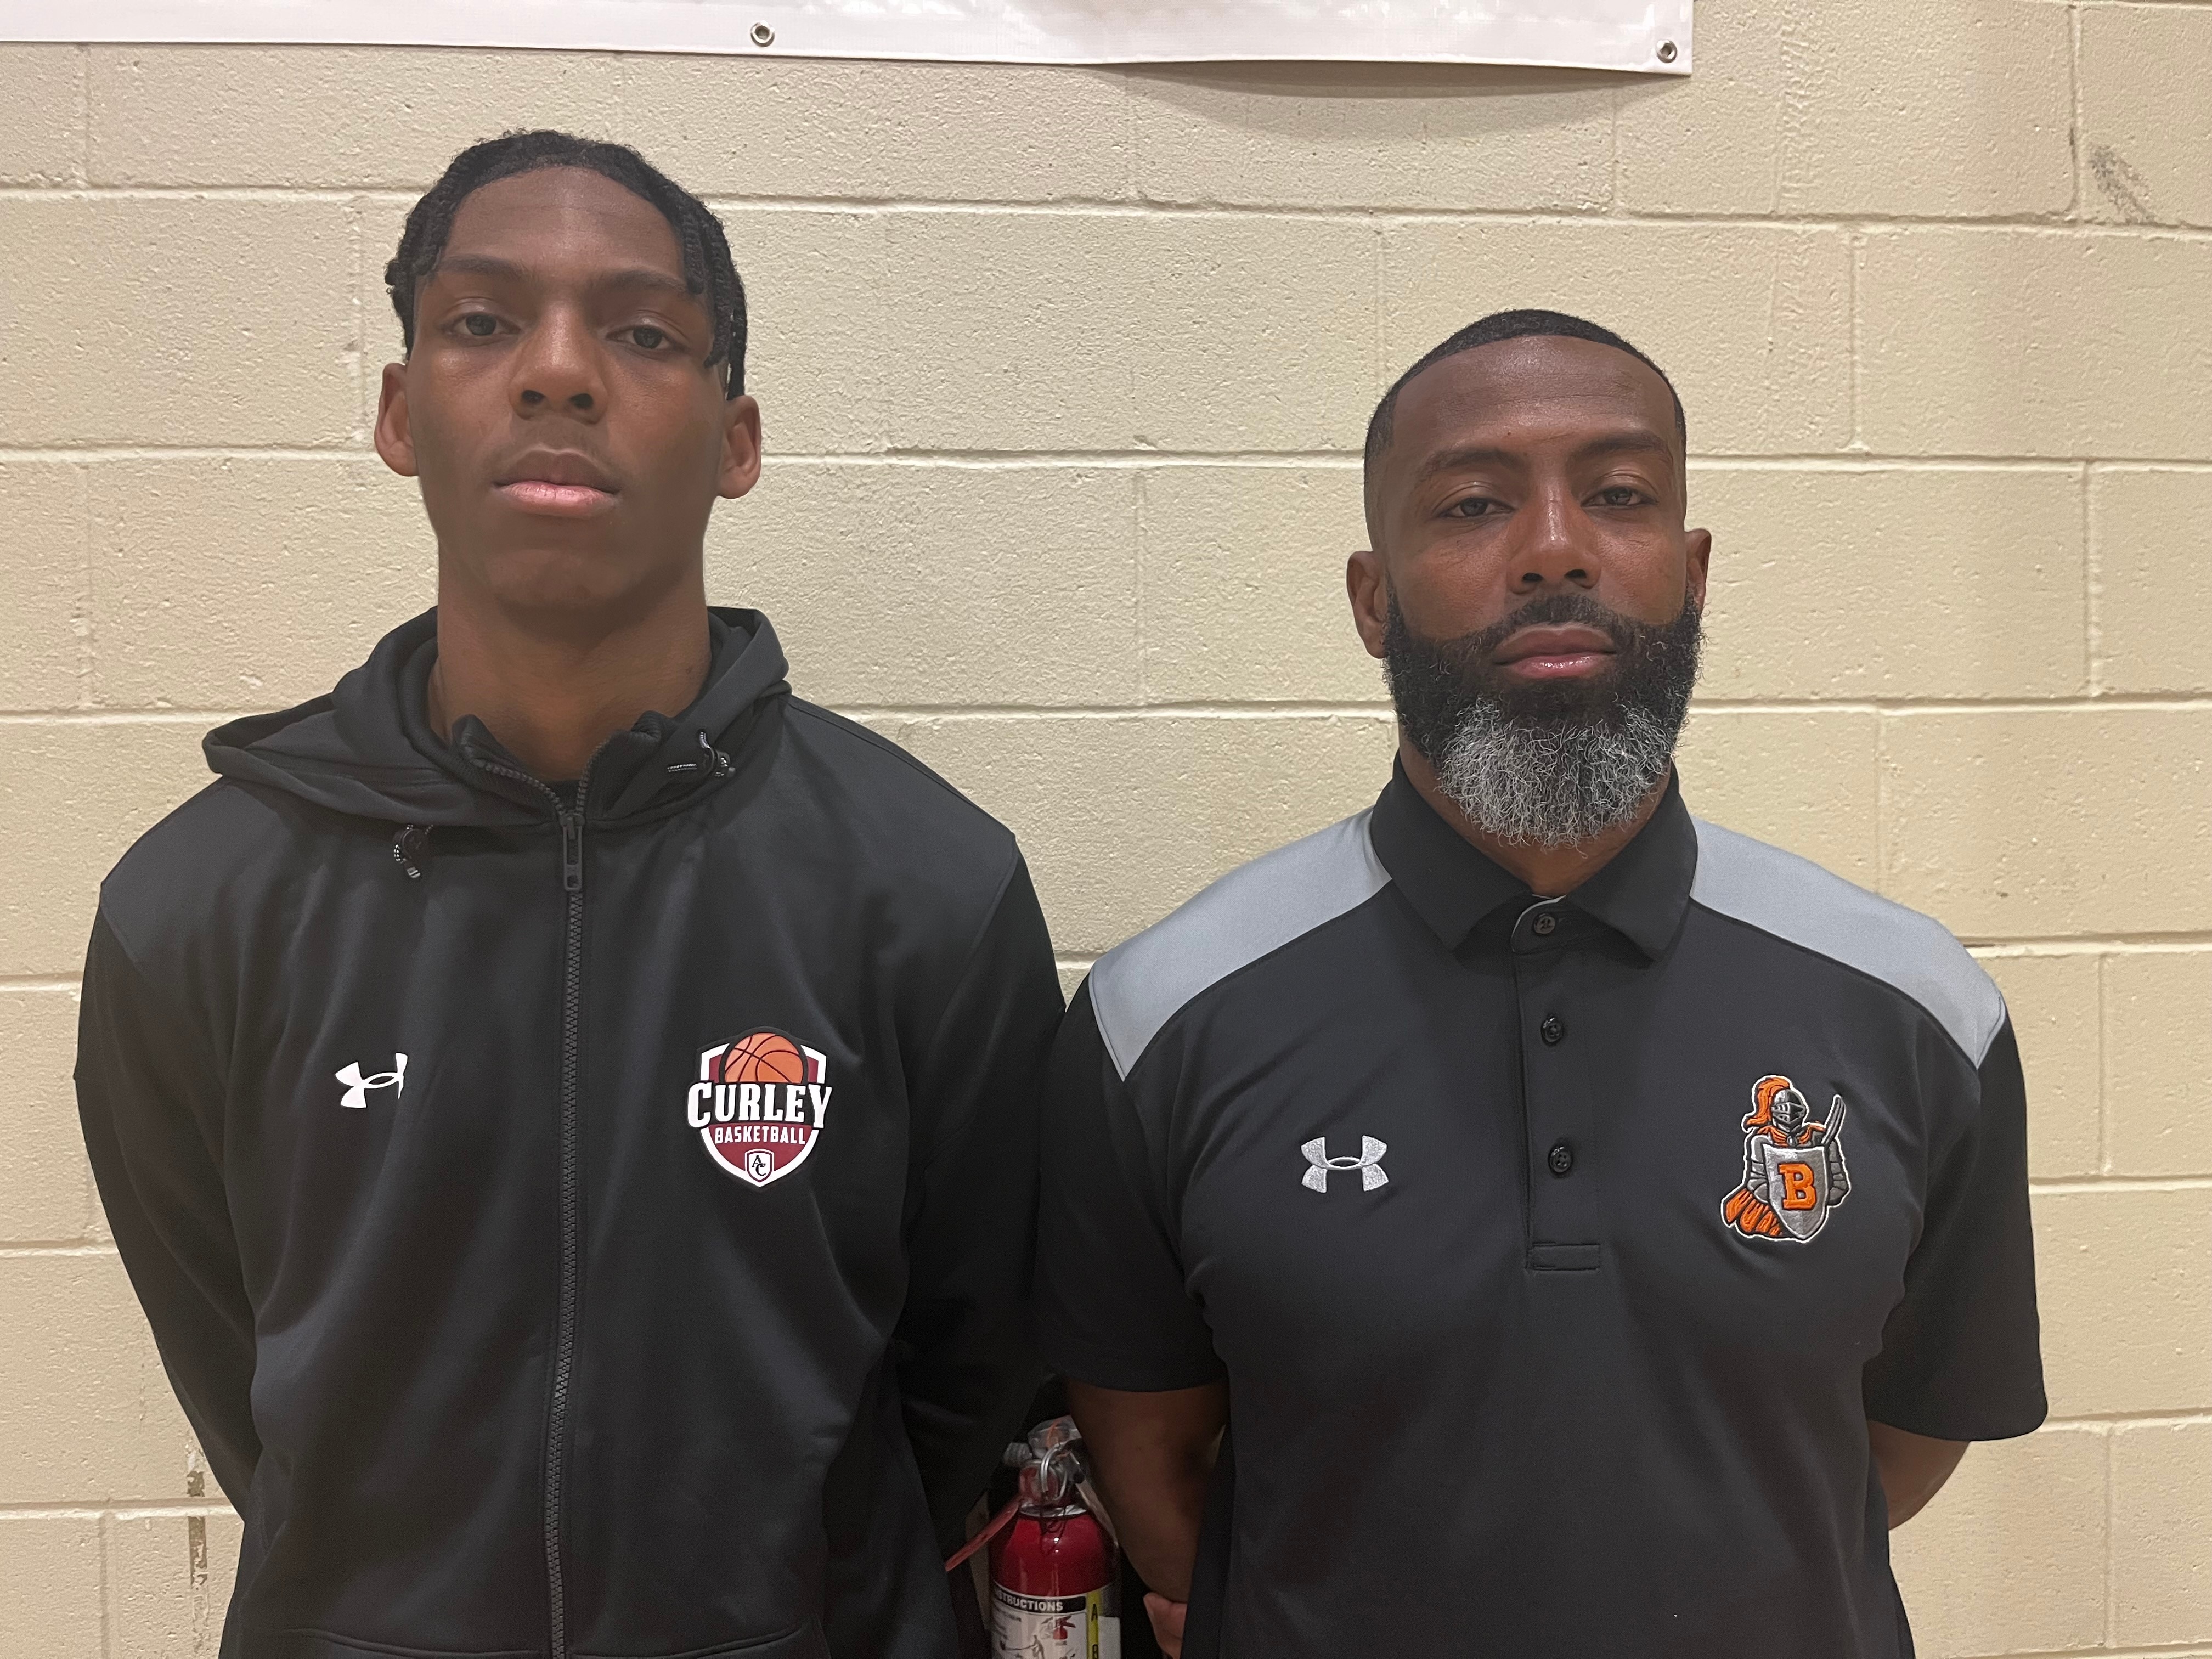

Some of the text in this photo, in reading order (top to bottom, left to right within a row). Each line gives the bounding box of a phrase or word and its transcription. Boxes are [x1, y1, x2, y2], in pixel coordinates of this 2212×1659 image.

[688, 1082, 832, 1128] CURLEY
[715, 1126, 806, 1144] BASKETBALL
[1778, 1163, 1817, 1210] B
[994, 1586, 1063, 1612] STRUCTIONS
